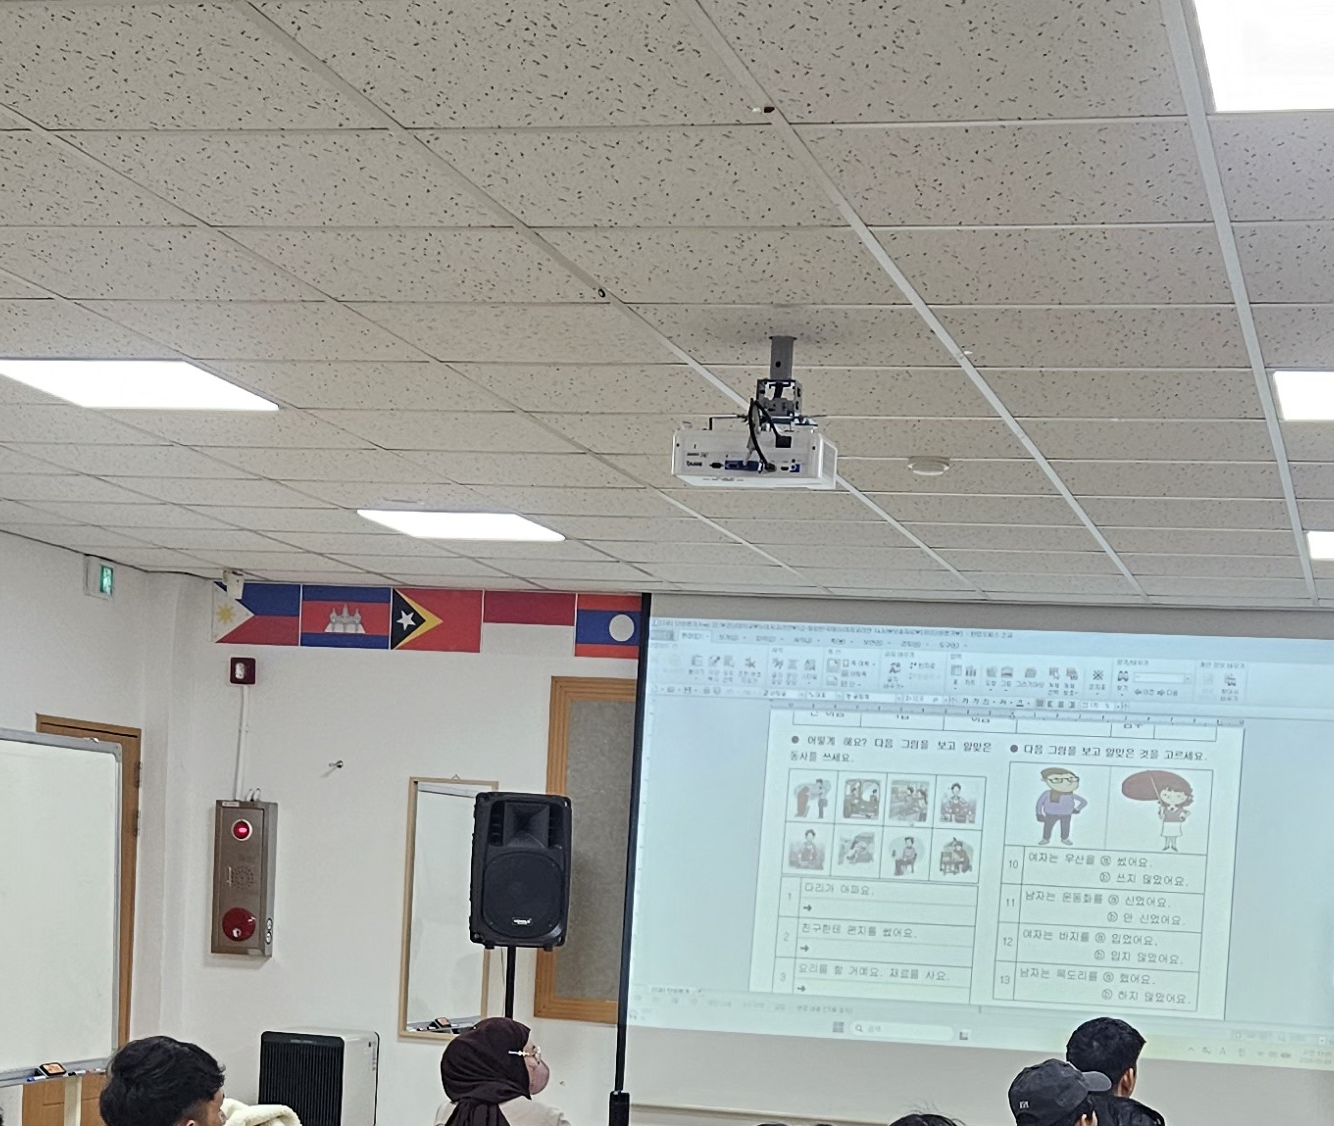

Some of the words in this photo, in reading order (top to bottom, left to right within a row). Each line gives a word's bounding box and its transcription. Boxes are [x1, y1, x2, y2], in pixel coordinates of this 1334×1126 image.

[875, 739, 893, 749] 다음
[901, 740, 929, 750] 그림을
[938, 741, 955, 750] 보고
[964, 742, 992, 752] 알맞은
[790, 751, 817, 762] 동사를
[1024, 745, 1042, 755] 다음
[1048, 746, 1076, 756] 그림을
[1082, 748, 1101, 757] 보고
[1106, 748, 1135, 759] 알맞은
[1140, 750, 1158, 760] 것을
[1166, 751, 1208, 761] 고르세요.
[1029, 852, 1058, 864] 여자는
[1065, 854, 1095, 865] 우산을
[1009, 860, 1018, 869] 10
[1117, 873, 1136, 883] 쓰지
[805, 882, 834, 893] 다리가
[1006, 899, 1015, 907] 11
[1025, 891, 1055, 902] 남자는
[1062, 892, 1102, 904] 운동화를
[802, 923, 841, 934] 친구한테
[847, 925, 877, 936] 편지를
[783, 932, 790, 942] 2
[1003, 937, 1013, 946] 12
[1023, 929, 1053, 941] 여자는
[1059, 931, 1089, 943] 바지를
[1111, 951, 1130, 962] 입지
[780, 972, 786, 982] 3
[799, 964, 828, 975] 요리를
[926, 969, 950, 981] 사요.
[1020, 968, 1050, 979] 남자는
[1056, 969, 1097, 982] 목도리를
[1000, 976, 1010, 984] 13
